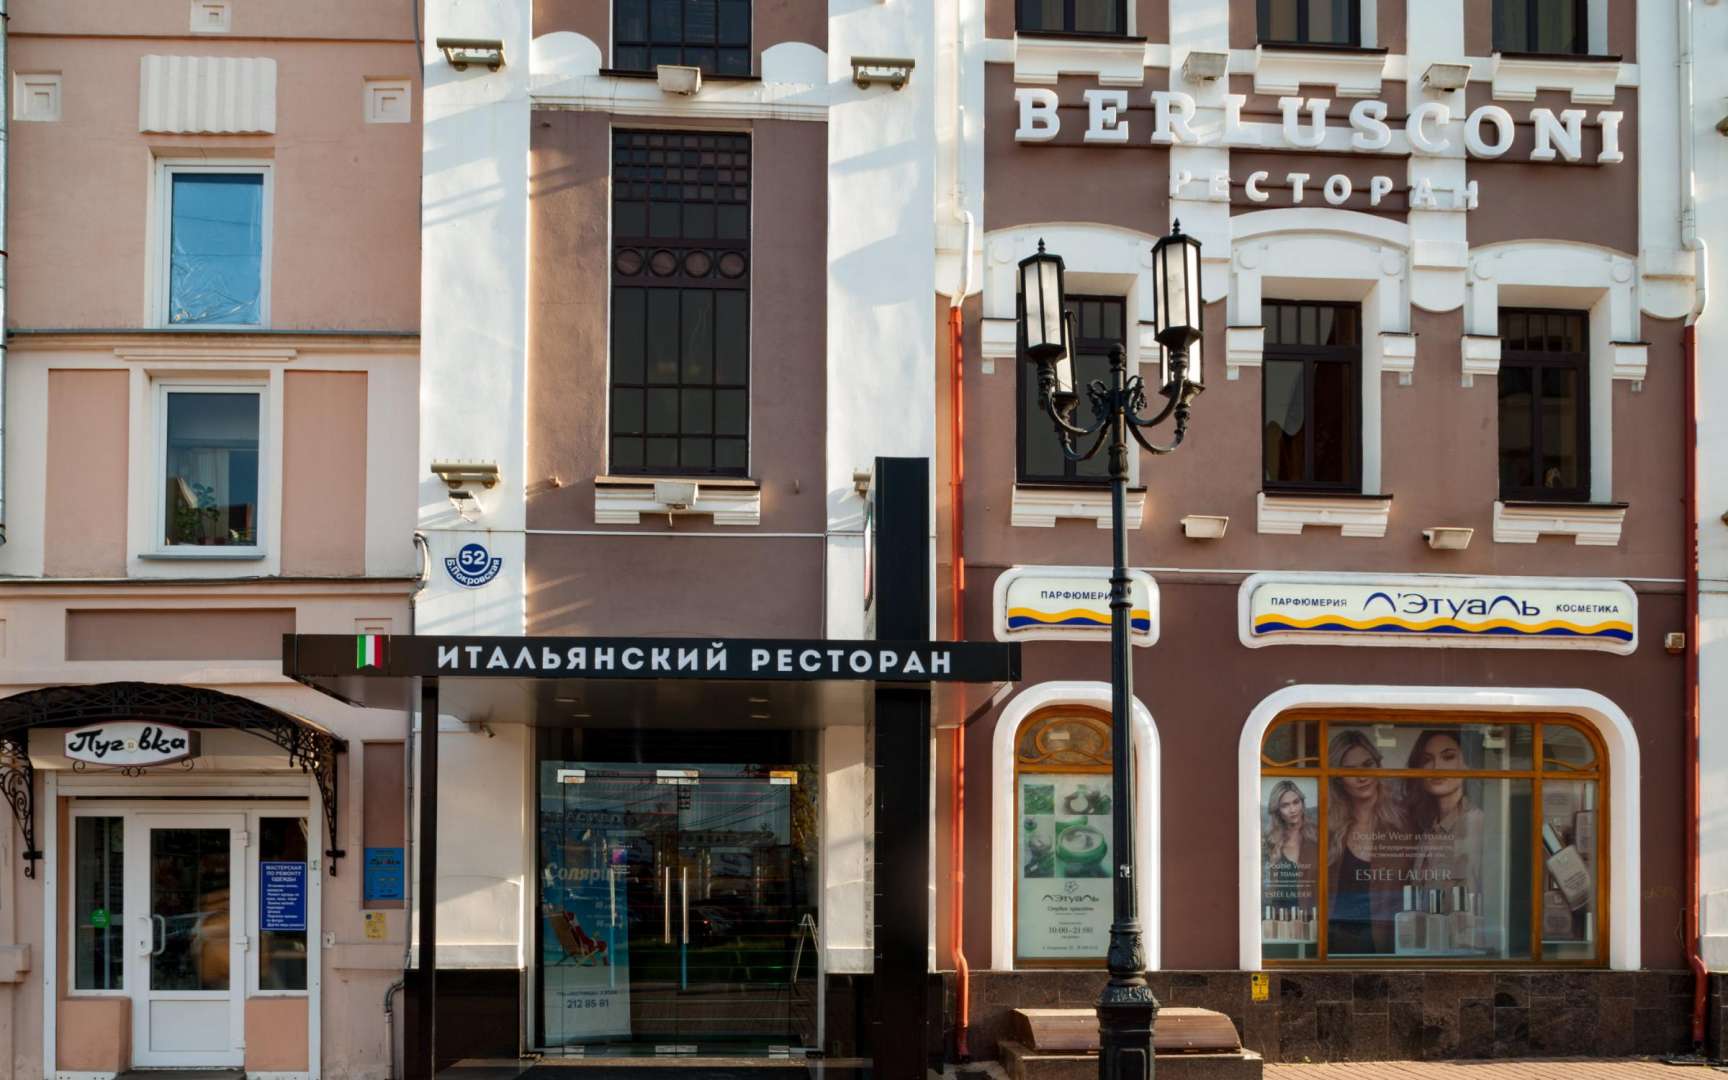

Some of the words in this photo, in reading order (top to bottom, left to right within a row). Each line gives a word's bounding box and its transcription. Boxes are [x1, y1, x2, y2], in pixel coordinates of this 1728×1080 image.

[1014, 87, 1624, 164] BERLUSCONI
[1174, 168, 1479, 210] РЕСТОРАН
[461, 550, 486, 566] 52
[1040, 590, 1112, 600] ПАРФЮМЕРИ
[1270, 596, 1348, 607] ПАРФЮМЕРИЯ
[1556, 603, 1619, 613] КОСМЕТИКА
[437, 641, 727, 671] ИТАЛЬЯНСКИЙ
[751, 648, 951, 673] РЕСТОРАН
[1398, 868, 1453, 881] LAUDER
